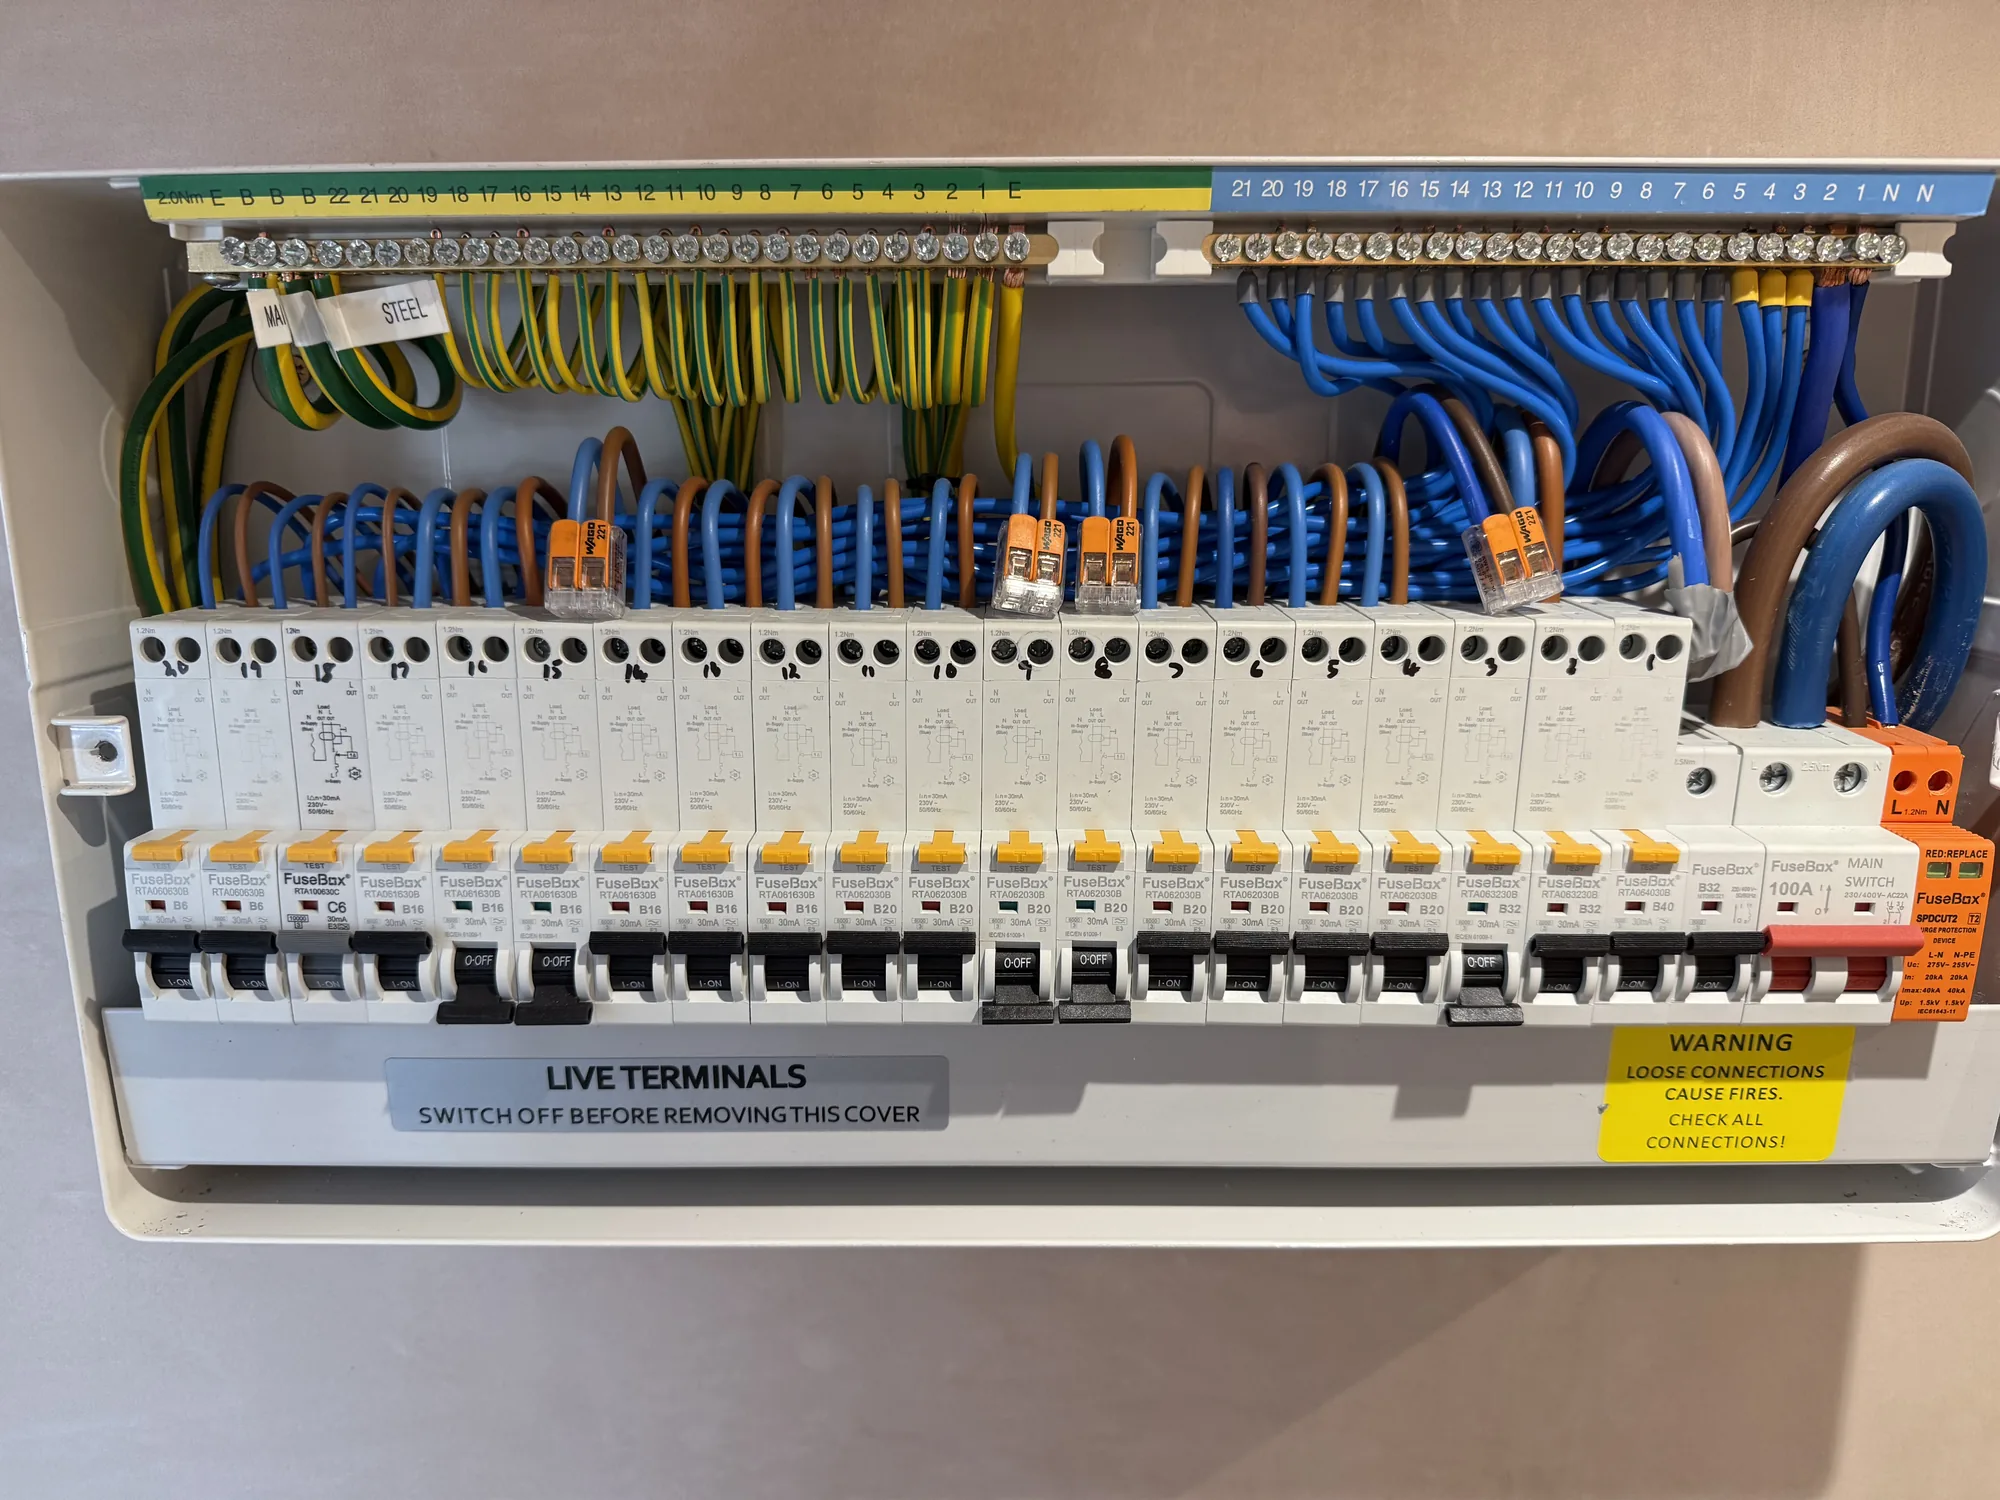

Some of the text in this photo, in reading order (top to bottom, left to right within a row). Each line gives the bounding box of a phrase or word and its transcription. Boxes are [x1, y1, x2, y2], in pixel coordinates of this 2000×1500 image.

[157, 180, 1022, 206] 2.0Nm E B B B 22 21 20 19 18 17 16 15 14 13 12 11 10 9 8 7 6 5 4 3 2 1 E
[1231, 179, 1935, 203] 21 20 19 18 17 16 15 14 13 12 11 10 9 8 7 6 5 4 3 2 1 N N
[382, 298, 428, 324] STEEL
[1525, 510, 1536, 526] 221
[597, 524, 605, 539] 221
[1054, 524, 1062, 538] 221
[1126, 522, 1134, 536] 221
[1515, 511, 1531, 543] WAGO
[586, 523, 595, 554] WAGO
[1115, 520, 1125, 550] WAGO
[468, 660, 488, 676] 16
[1250, 660, 1263, 678] 6
[1327, 659, 1339, 678] 5
[1892, 800, 1902, 814] L
[1936, 800, 1949, 814] N
[1847, 858, 1883, 869] MAIN
[1699, 883, 1720, 892] B32
[1769, 881, 1813, 896] 100A
[1845, 877, 1895, 887] SWITCH
[520, 890, 577, 898] RTA061630B
[1066, 889, 1122, 897] RTA062030B
[1461, 890, 1518, 899] RTA063230B
[173, 901, 188, 910] B6
[328, 902, 347, 913] C6
[560, 905, 582, 914] B16
[1104, 903, 1128, 913] B20
[1499, 904, 1521, 914] B32
[1652, 902, 1674, 911] B40
[541, 919, 563, 927] 30mA
[1087, 917, 1108, 926] 30mA
[1916, 915, 1980, 923] SPDCUT2 T2
[1669, 1033, 1794, 1052] WARNING
[546, 1064, 807, 1091] LIVE TERMINALS
[1627, 1065, 1825, 1079] LOOSE CONNECTIONS
[1665, 1087, 1783, 1100] CAUSE FIRES.
[419, 1105, 921, 1125] SWITCH OFF BEFORE REMOVING THIS COVER
[1669, 1113, 1763, 1126] CHECK ALL
[1646, 1135, 1786, 1149] CONNECTIONS!
